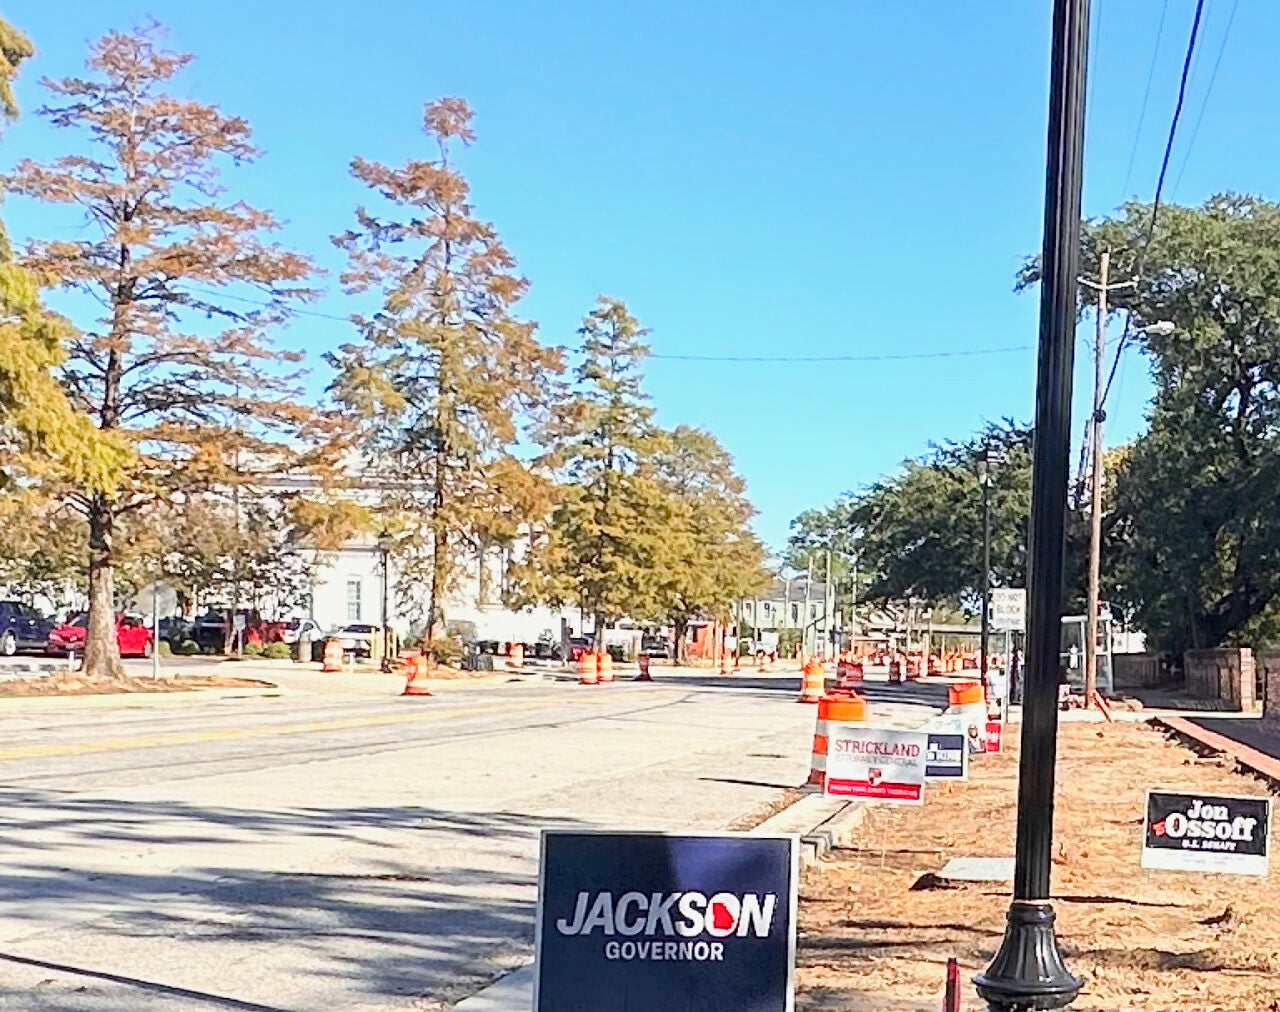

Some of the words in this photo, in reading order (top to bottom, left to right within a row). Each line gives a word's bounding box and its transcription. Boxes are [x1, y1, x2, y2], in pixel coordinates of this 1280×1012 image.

[835, 739, 920, 757] STRICKLAND
[1186, 799, 1229, 821] Jon
[1165, 812, 1257, 842] Ossoff
[556, 891, 777, 937] JACKSON
[605, 940, 725, 961] GOVERNOR
